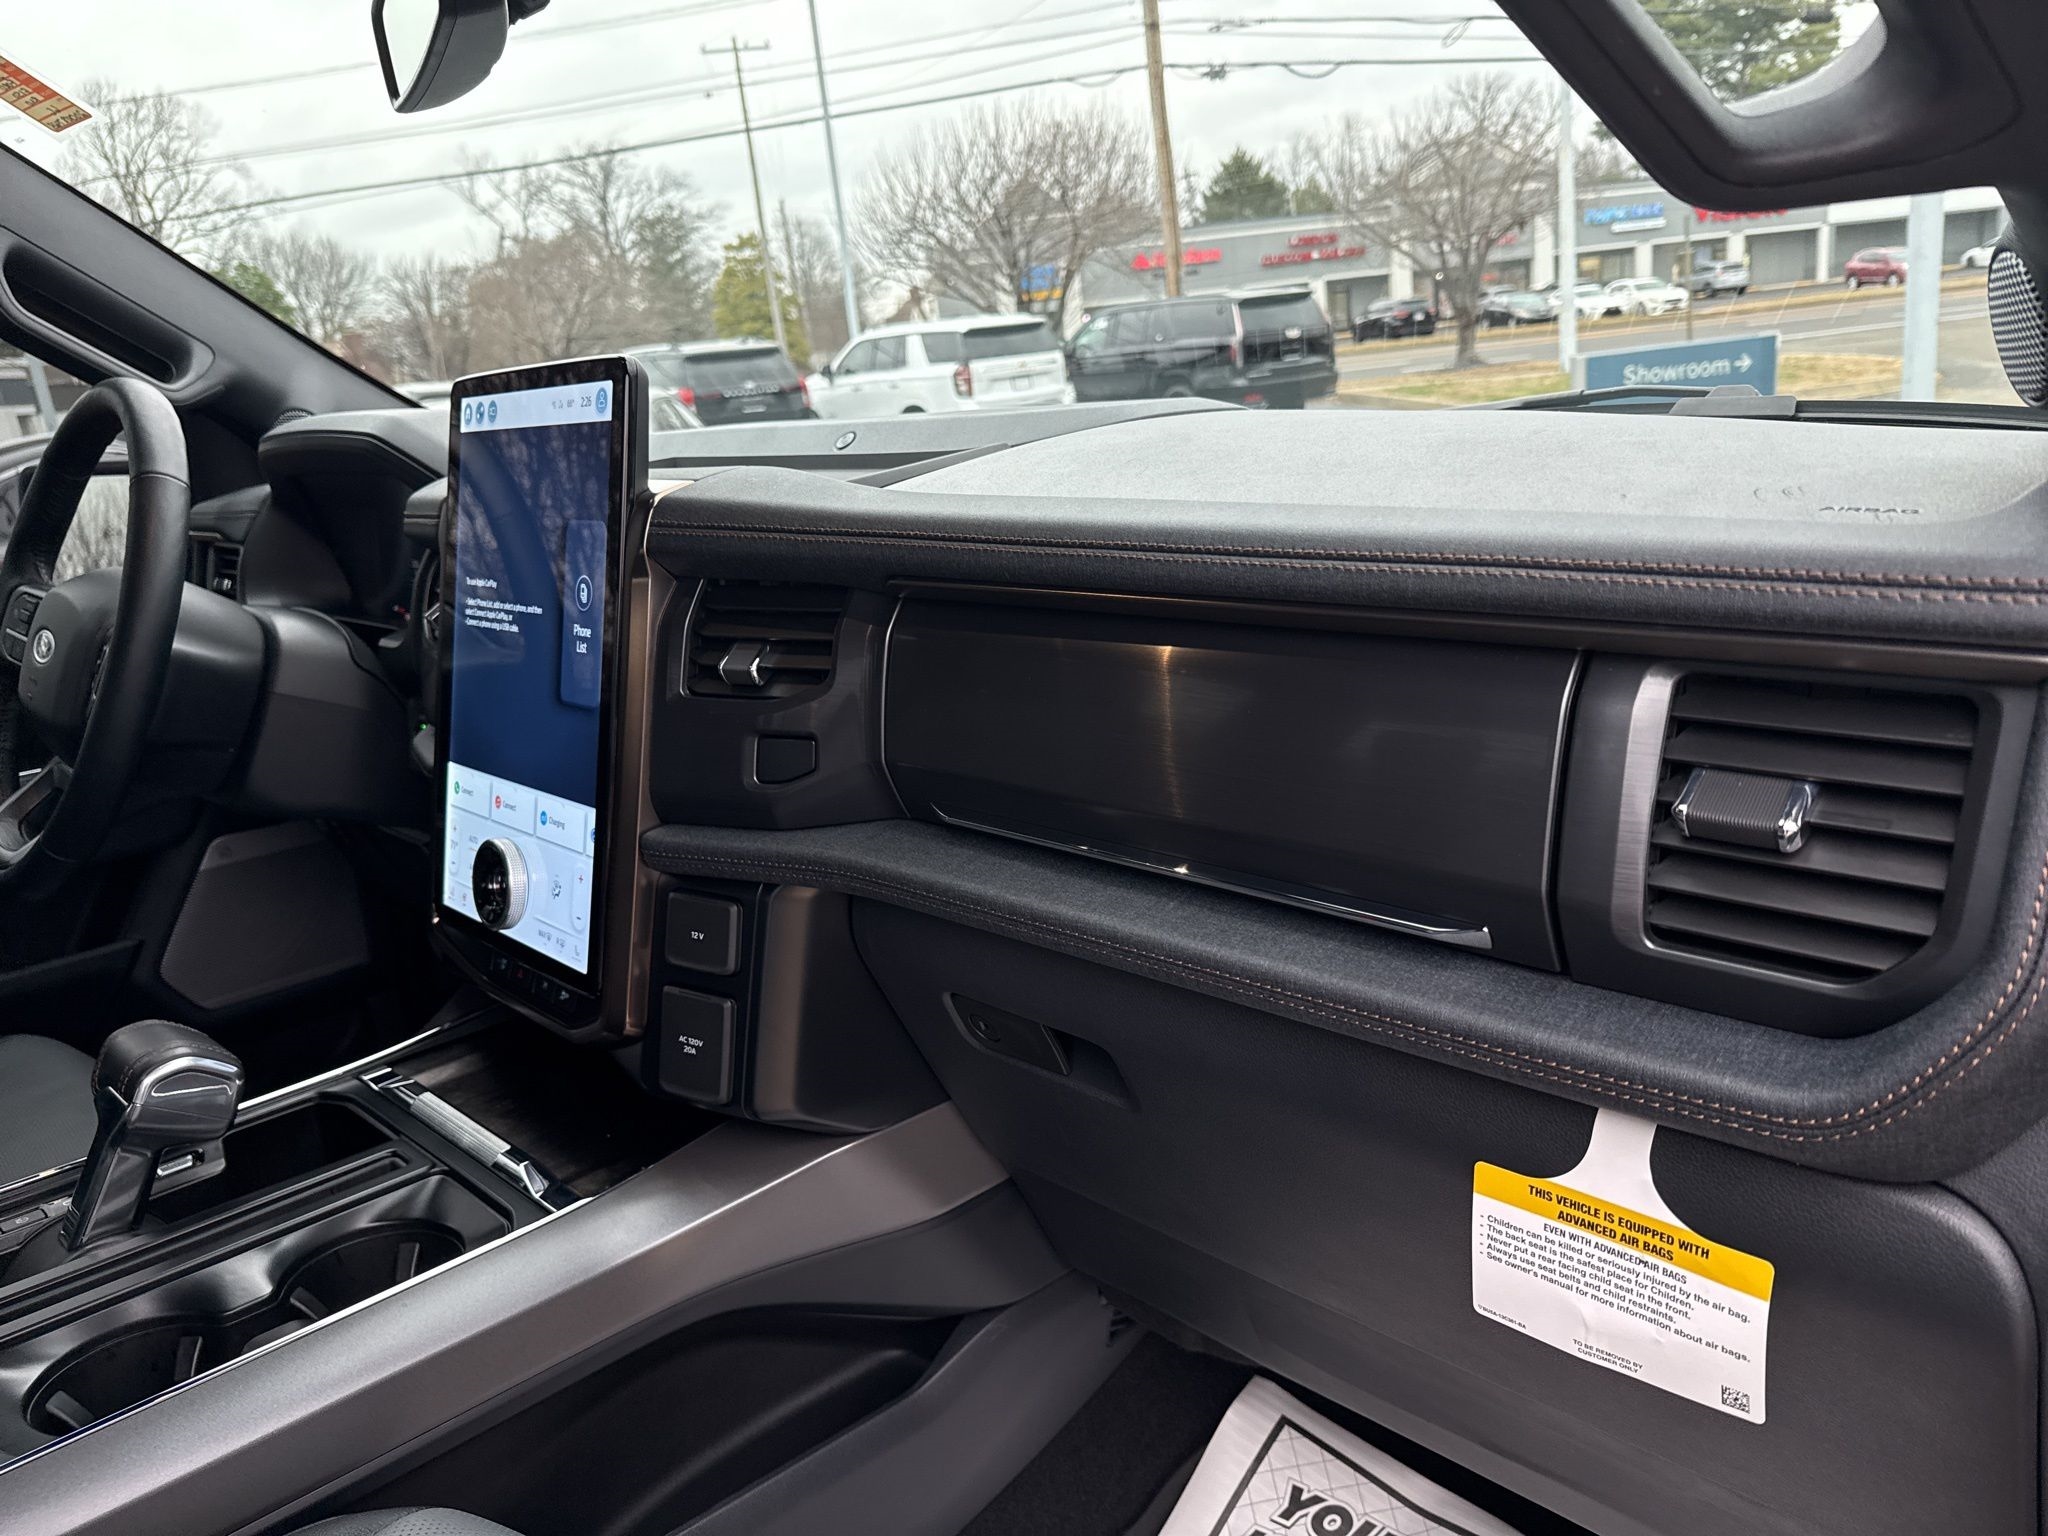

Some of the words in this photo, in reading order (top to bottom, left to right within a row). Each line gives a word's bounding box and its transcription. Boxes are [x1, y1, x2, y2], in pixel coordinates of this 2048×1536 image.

[1622, 358, 1731, 385] Showroom
[1818, 506, 1919, 515] AIRBAG
[574, 624, 591, 638] Phone
[577, 640, 587, 654] List
[462, 786, 474, 796] Connect
[502, 800, 516, 811] Connect
[549, 816, 565, 830] Charging
[679, 1035, 688, 1043] AC
[688, 1038, 704, 1047] 120V
[684, 1045, 696, 1055] 20A
[1528, 1184, 1553, 1202] THIS
[1556, 1194, 1600, 1219] VEHICLE
[1604, 1212, 1615, 1224] IS
[1618, 1218, 1674, 1246] EQUIPPED
[1678, 1238, 1710, 1260] WITH
[1558, 1210, 1616, 1240] ADVANCED
[1620, 1232, 1640, 1248] AIR
[1643, 1241, 1674, 1262] BAGS
[1488, 1224, 1503, 1236] The
[1506, 1231, 1526, 1245] back
[1528, 1241, 1547, 1252] seat
[1549, 1247, 1557, 1256] is
[1560, 1251, 1574, 1262] the
[1577, 1258, 1605, 1273] safest
[1607, 1270, 1632, 1284] place
[1635, 1280, 1648, 1290] for
[1651, 1286, 1694, 1310] Children.
[1544, 1223, 1566, 1238] EVEN
[1569, 1231, 1592, 1248] WITH
[1594, 1242, 1641, 1266] ADVANCED
[1644, 1260, 1660, 1274] AIR
[1662, 1267, 1687, 1284] BAGS
[1487, 1214, 1524, 1234] Children
[1526, 1230, 1542, 1241] can
[1545, 1236, 1555, 1245] be
[1558, 1240, 1582, 1256] killed
[1585, 1251, 1595, 1260] or
[1598, 1256, 1640, 1278] seriously
[1644, 1272, 1676, 1292] injured
[1679, 1287, 1691, 1300] by
[1694, 1293, 1710, 1306] the
[1712, 1302, 1726, 1312] air
[1728, 1307, 1750, 1324] bag.
[1487, 1233, 1512, 1248] Never
[1514, 1245, 1528, 1255] put
[1538, 1254, 1556, 1265] rear
[1558, 1260, 1586, 1278] facing
[1589, 1272, 1611, 1286] child
[1614, 1282, 1634, 1295] seat
[1636, 1290, 1645, 1300] in
[1648, 1294, 1663, 1307] the
[1665, 1302, 1691, 1320] front.
[1487, 1243, 1517, 1260] Always
[1520, 1256, 1535, 1267] use
[1538, 1264, 1556, 1275] seat
[1559, 1270, 1581, 1285] belts
[1583, 1281, 1600, 1292] and
[1603, 1288, 1626, 1302] child
[1628, 1298, 1676, 1324] restraints.
[1487, 1252, 1502, 1264] See
[1505, 1260, 1538, 1278] owner's
[1541, 1274, 1573, 1292] manual
[1576, 1286, 1588, 1297] for
[1591, 1294, 1614, 1308] more
[1617, 1302, 1671, 1332] information
[1674, 1328, 1702, 1344] about
[1705, 1340, 1719, 1350] air
[1721, 1346, 1750, 1362] bags.
[1572, 1338, 1583, 1347] TO
[1584, 1343, 1594, 1351] BE
[1596, 1348, 1631, 1365] REMOVED
[1577, 1347, 1618, 1366] CUSTOMER
[1619, 1362, 1638, 1374] ONLY
